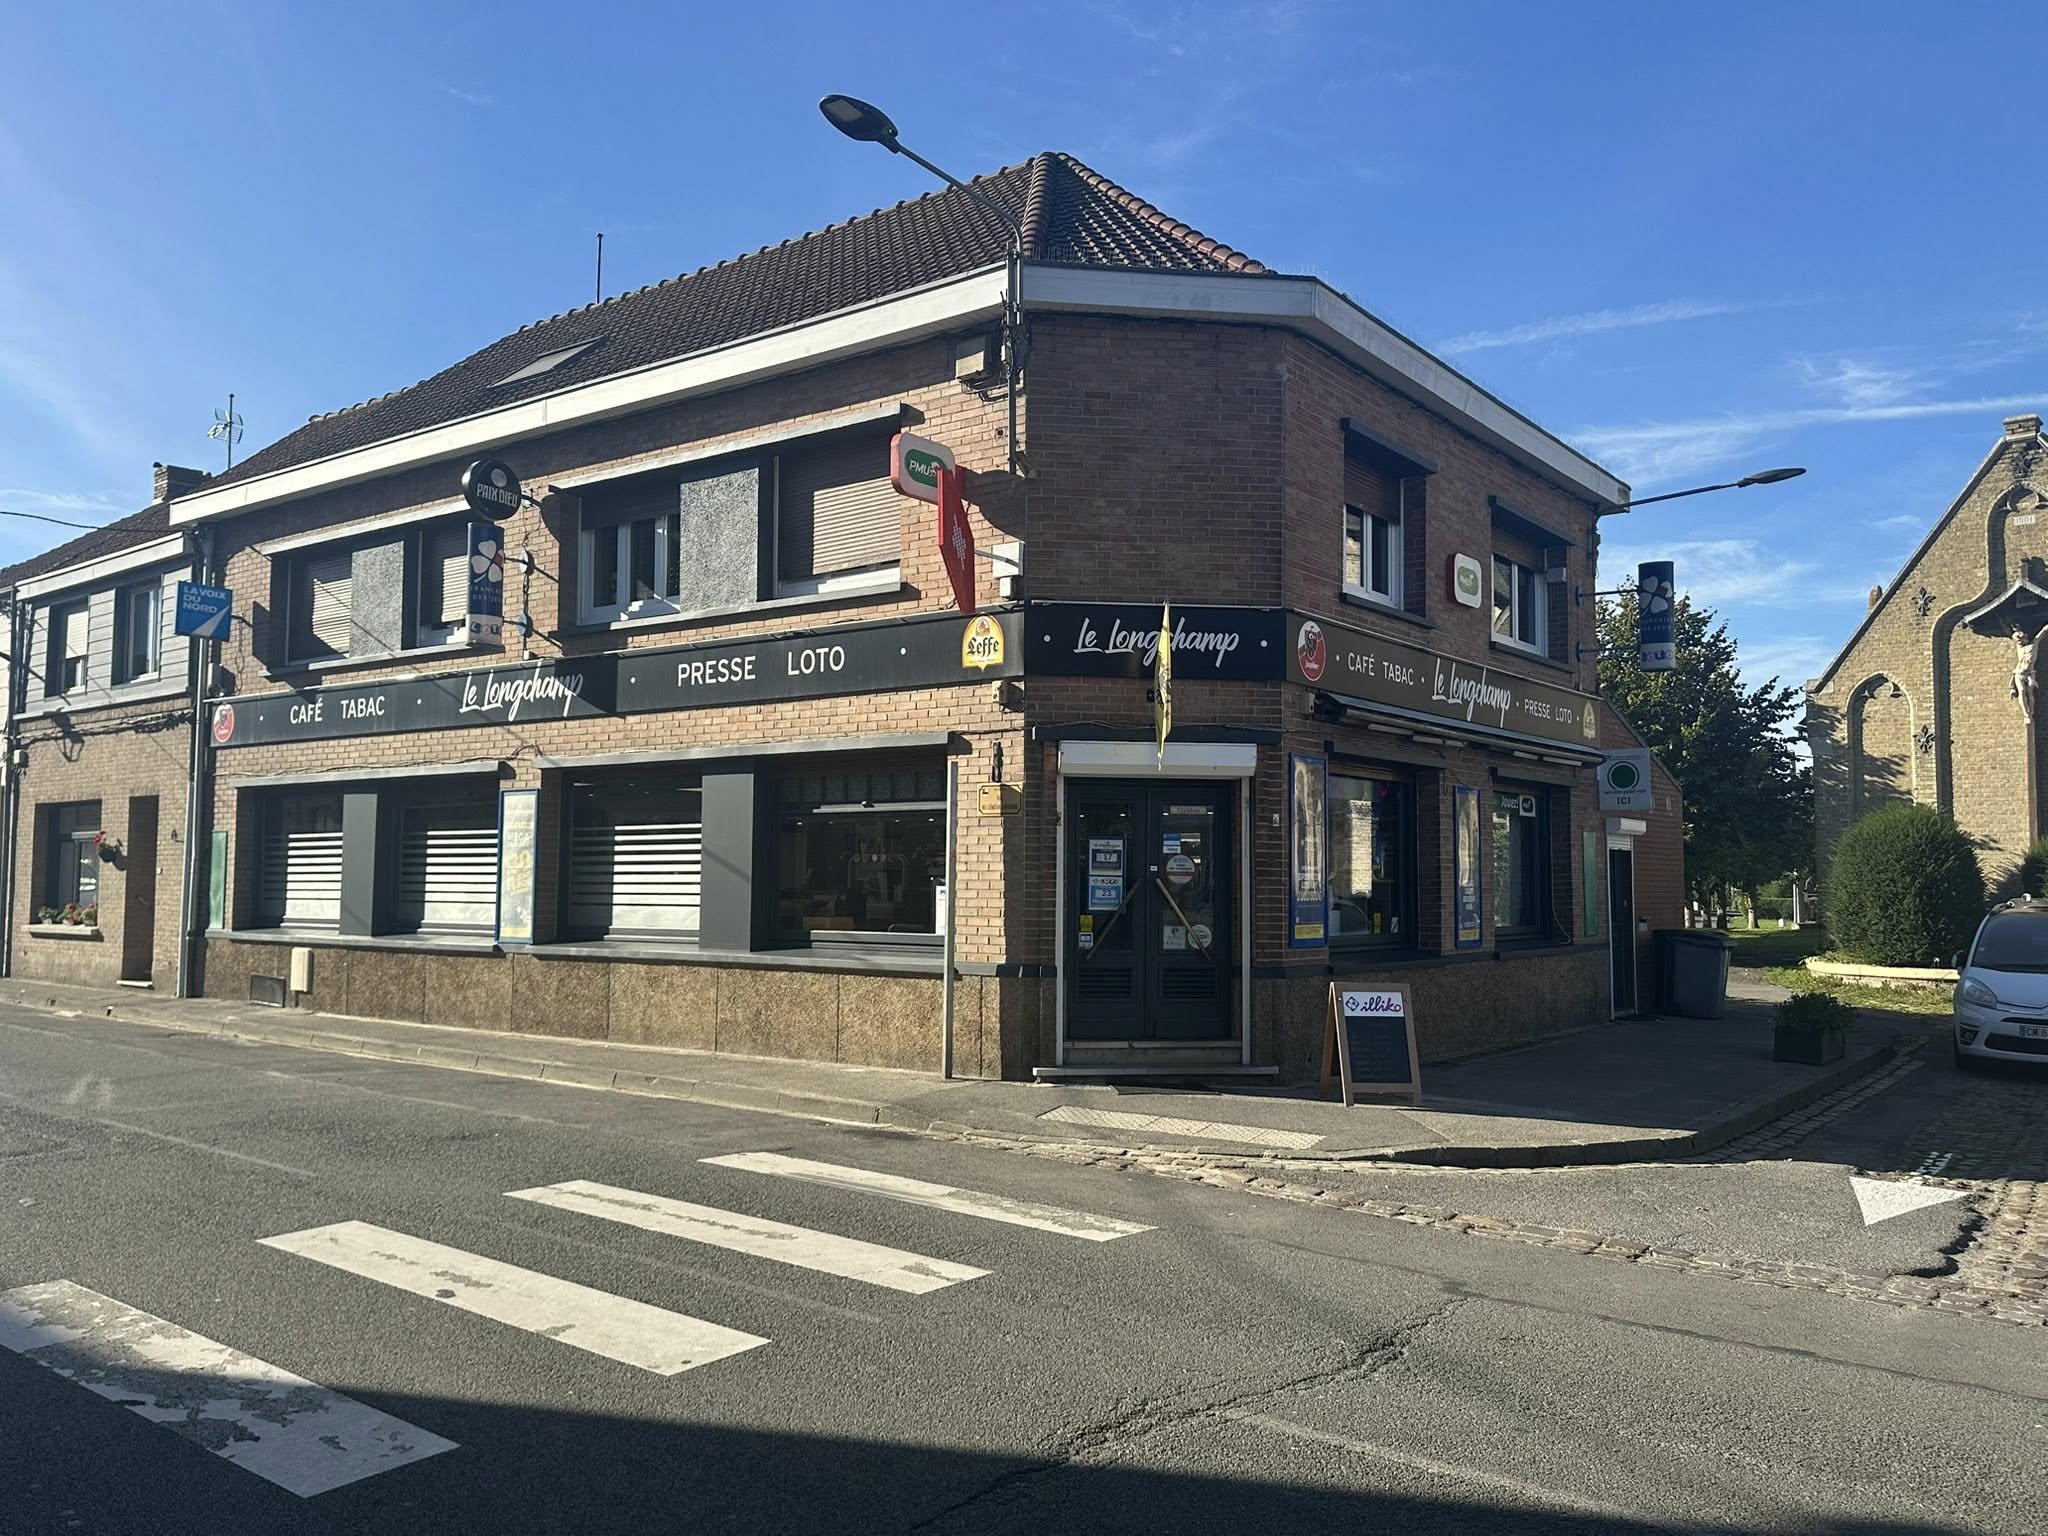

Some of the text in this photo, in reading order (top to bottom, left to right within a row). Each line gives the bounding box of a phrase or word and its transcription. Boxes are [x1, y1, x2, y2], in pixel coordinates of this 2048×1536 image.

[909, 459, 931, 476] PMU
[476, 483, 518, 508] PAIX DIEU
[183, 586, 227, 600] LA VOIX
[183, 594, 201, 603] DU
[183, 602, 218, 614] NORD
[470, 622, 500, 635] LOT
[966, 636, 1000, 658] Leffe
[1073, 617, 1240, 668] Le Longhamp
[677, 645, 845, 687] PRESSE LOTO
[290, 660, 584, 725] CAFÉ TABAC Le Longchamp
[1348, 652, 1573, 728] CAFÉ TABAC Le Longchamp PRESSE LOTO
[1617, 796, 1631, 805] ICI
[1101, 889, 1112, 897] 23
[1360, 996, 1402, 1012] illiko
